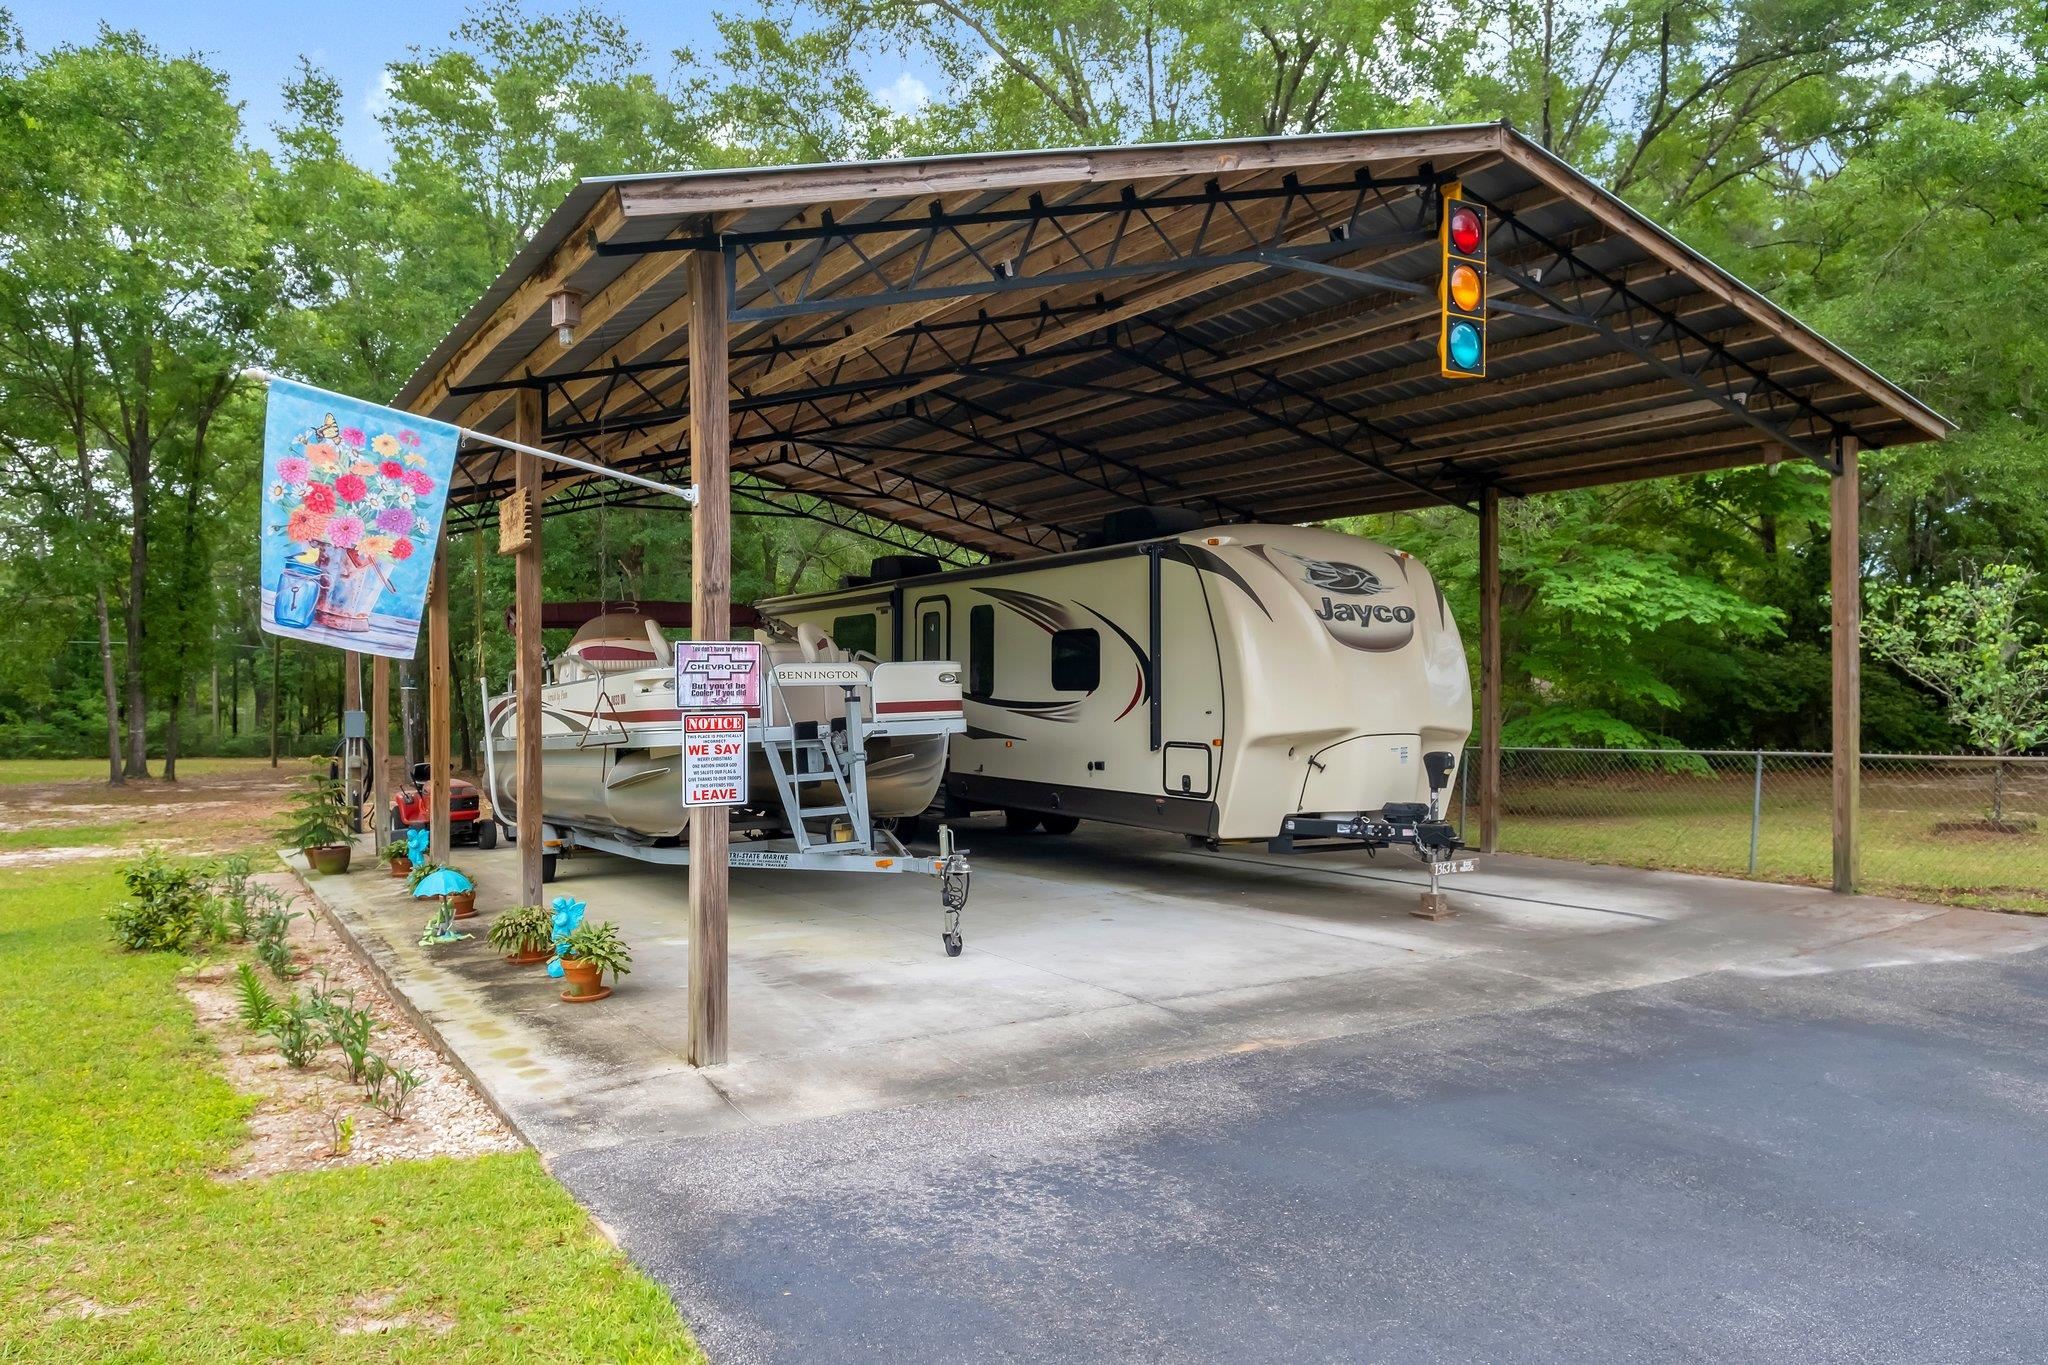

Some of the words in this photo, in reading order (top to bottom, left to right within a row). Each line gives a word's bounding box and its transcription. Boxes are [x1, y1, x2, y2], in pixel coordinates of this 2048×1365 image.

[1314, 597, 1416, 628] Jayco
[779, 670, 858, 679] BENNINGTON
[688, 718, 741, 730] NOTICE
[688, 745, 709, 755] WE
[714, 744, 741, 754] SAY
[693, 789, 737, 800] LEAVE
